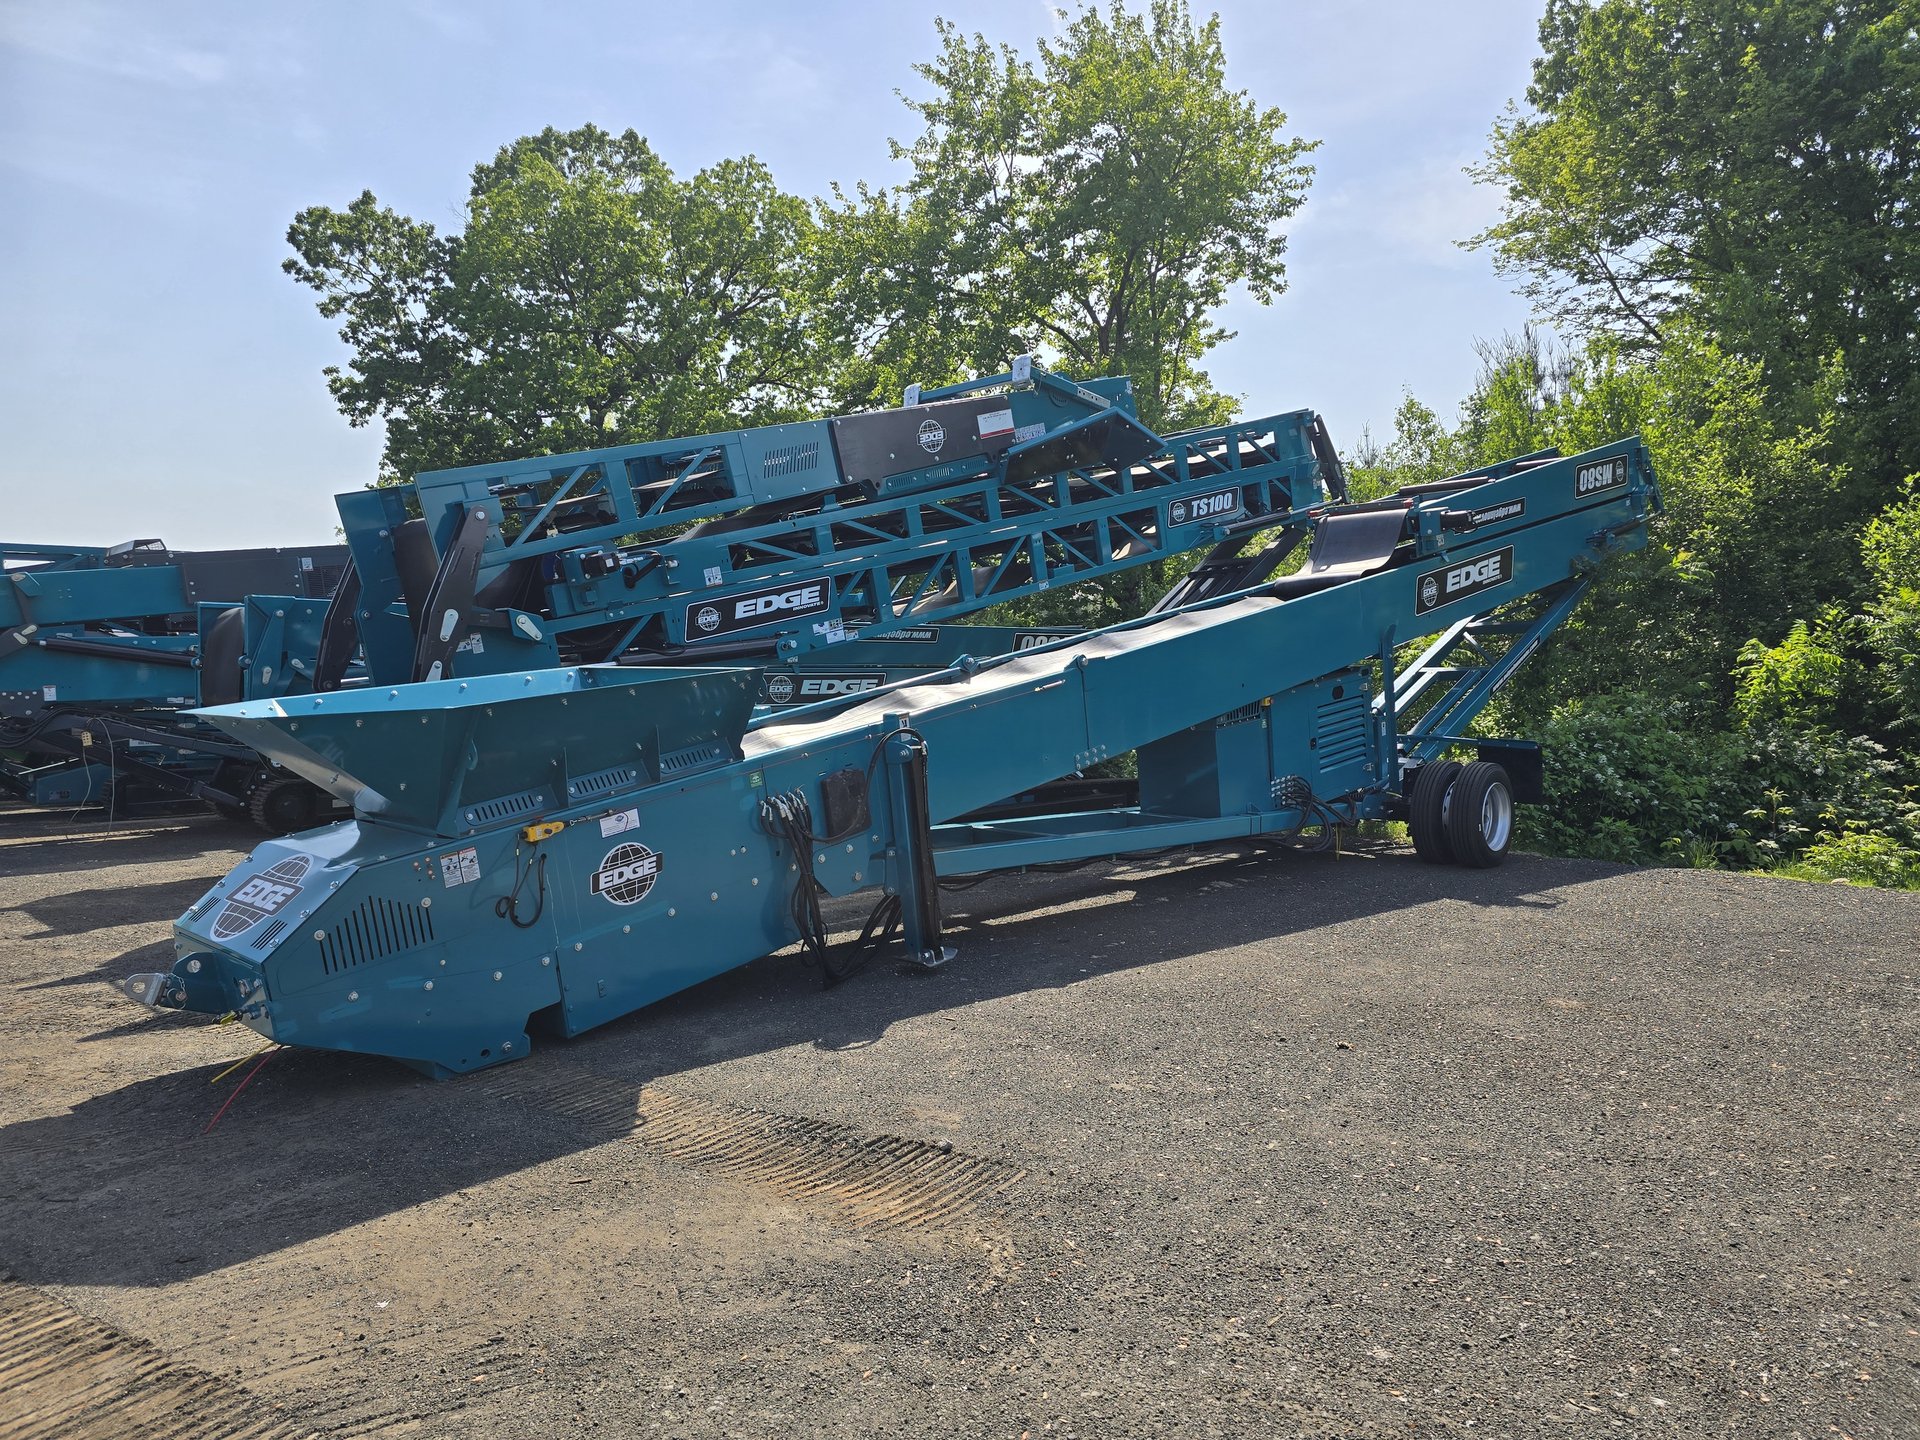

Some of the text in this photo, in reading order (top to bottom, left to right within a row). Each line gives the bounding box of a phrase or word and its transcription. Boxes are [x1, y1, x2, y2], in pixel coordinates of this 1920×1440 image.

[1579, 463, 1613, 492] MS80
[1192, 493, 1233, 518] TS100
[1447, 555, 1501, 593] EDGE
[697, 585, 821, 624] EDGE EDGE
[769, 679, 879, 695] EDGE EDGE
[599, 856, 657, 890] EDGE
[232, 877, 296, 912] EDGE
